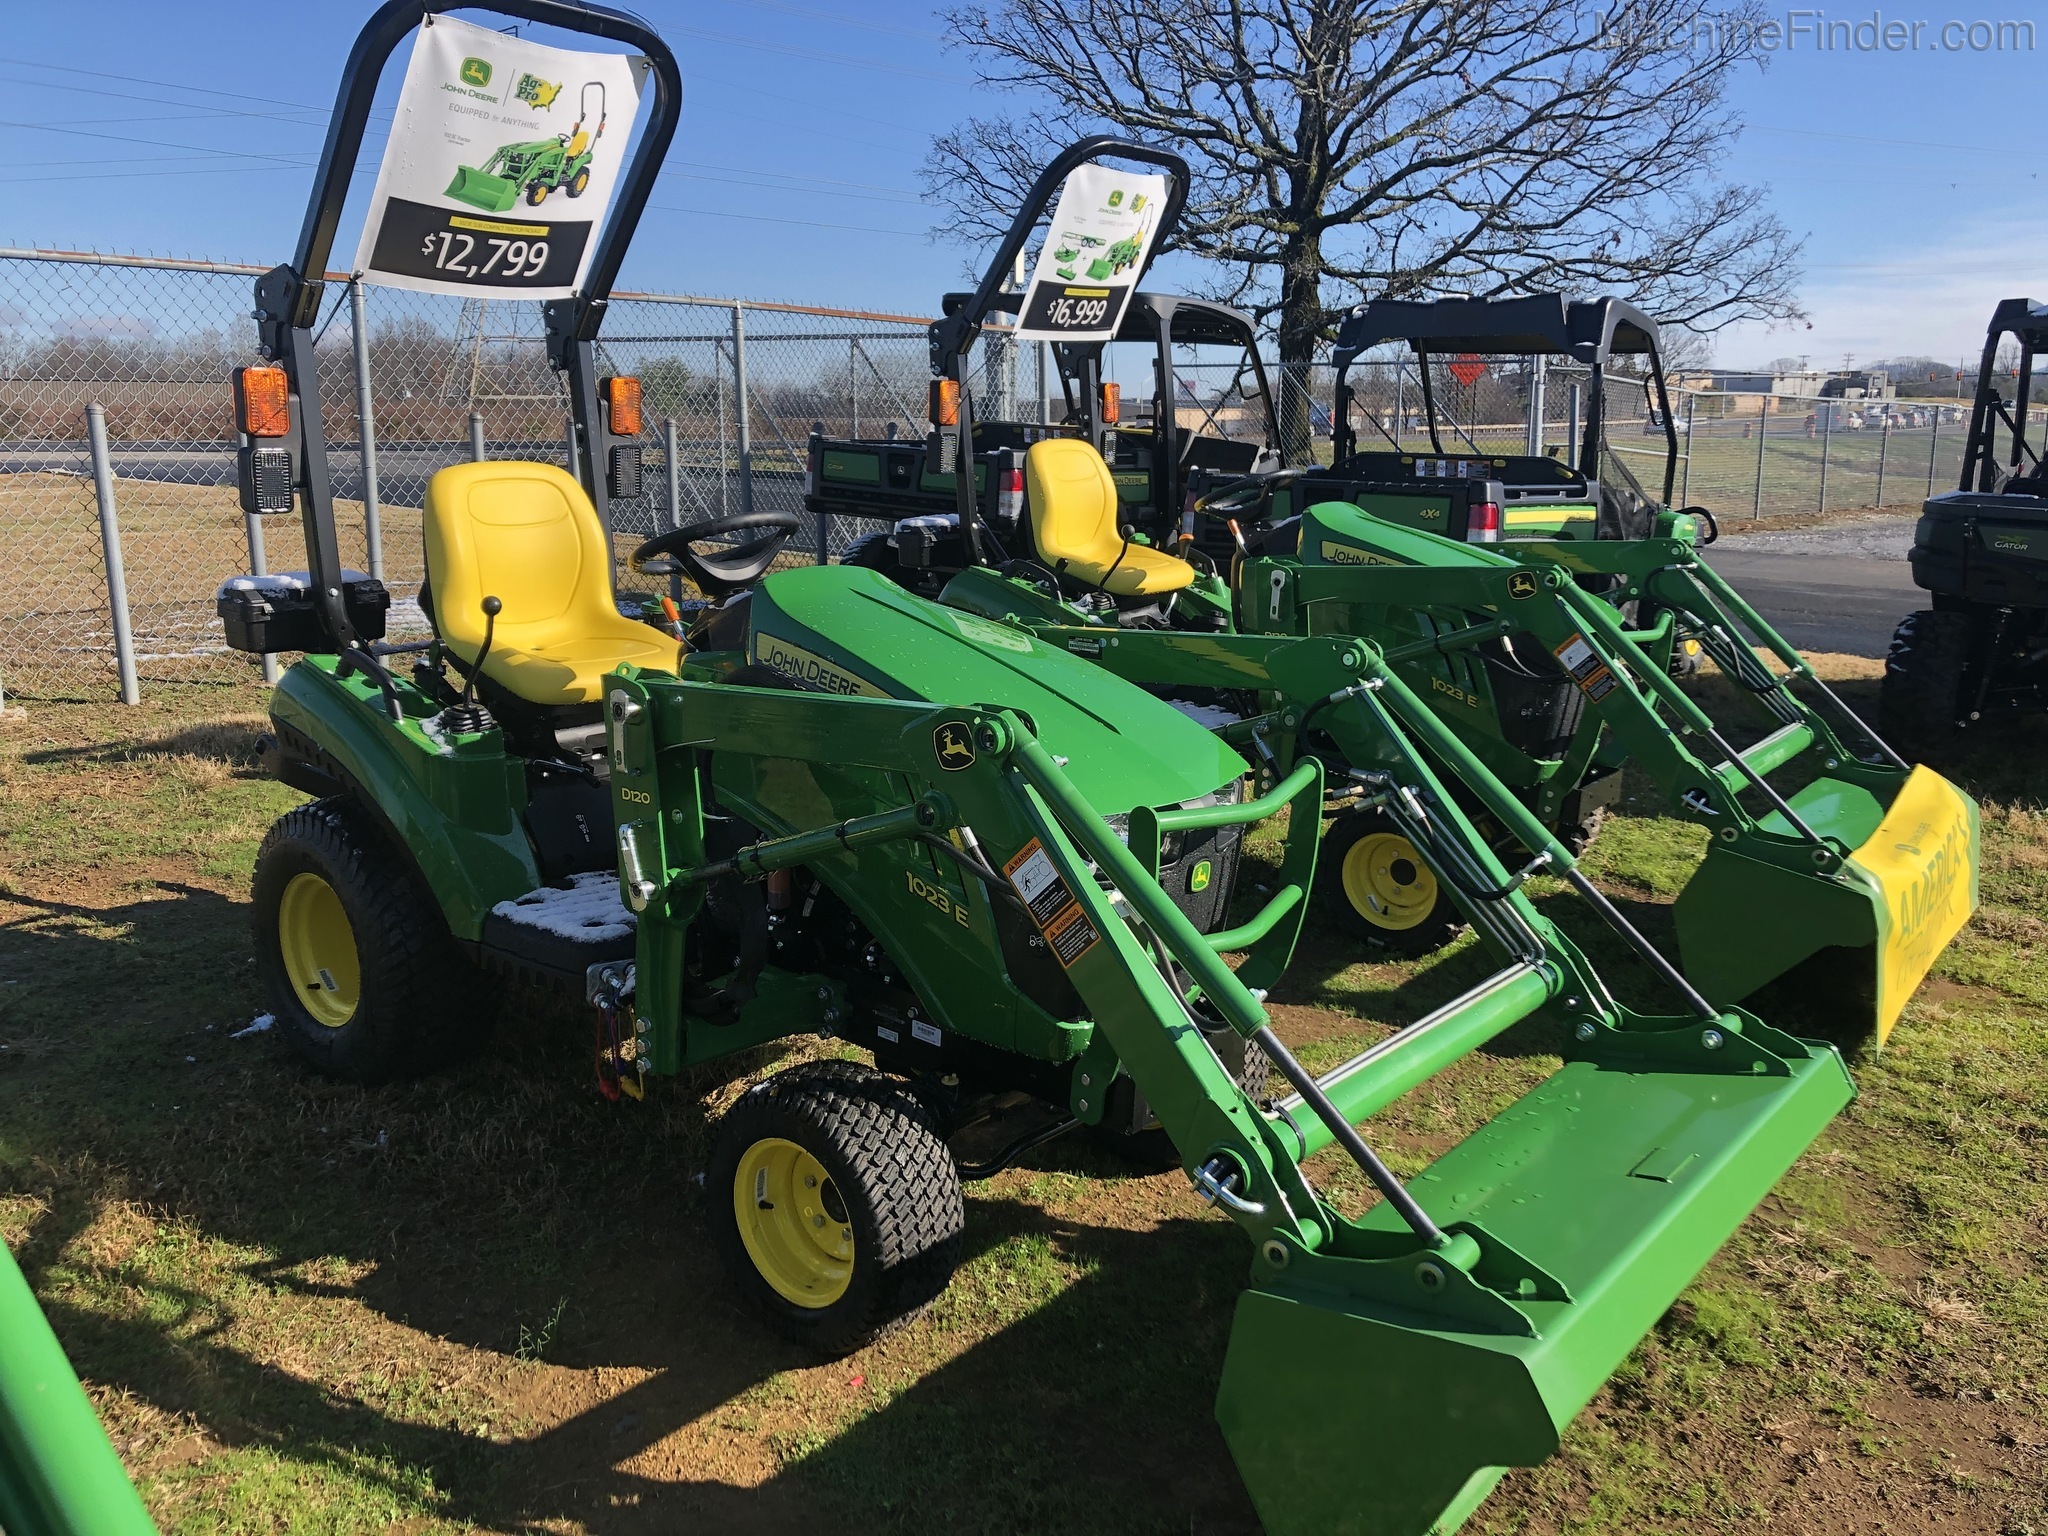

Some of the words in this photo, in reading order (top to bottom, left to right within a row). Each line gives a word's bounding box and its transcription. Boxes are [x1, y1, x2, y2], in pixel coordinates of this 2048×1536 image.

[440, 82, 467, 96] JOHN
[468, 89, 499, 104] DEERE
[515, 86, 540, 101] Pro
[449, 102, 490, 120] EQUIPPED
[501, 116, 540, 130] ANYTHING
[421, 231, 549, 278] $12,799
[1047, 299, 1107, 328] $16,999
[1329, 548, 1365, 565] JOHN
[1994, 540, 2028, 551] GATOR
[763, 645, 805, 678] JOHN
[806, 659, 861, 696] DEERE
[621, 787, 650, 805] D120
[1013, 843, 1037, 867] WARNING
[1055, 908, 1080, 932] WARNING
